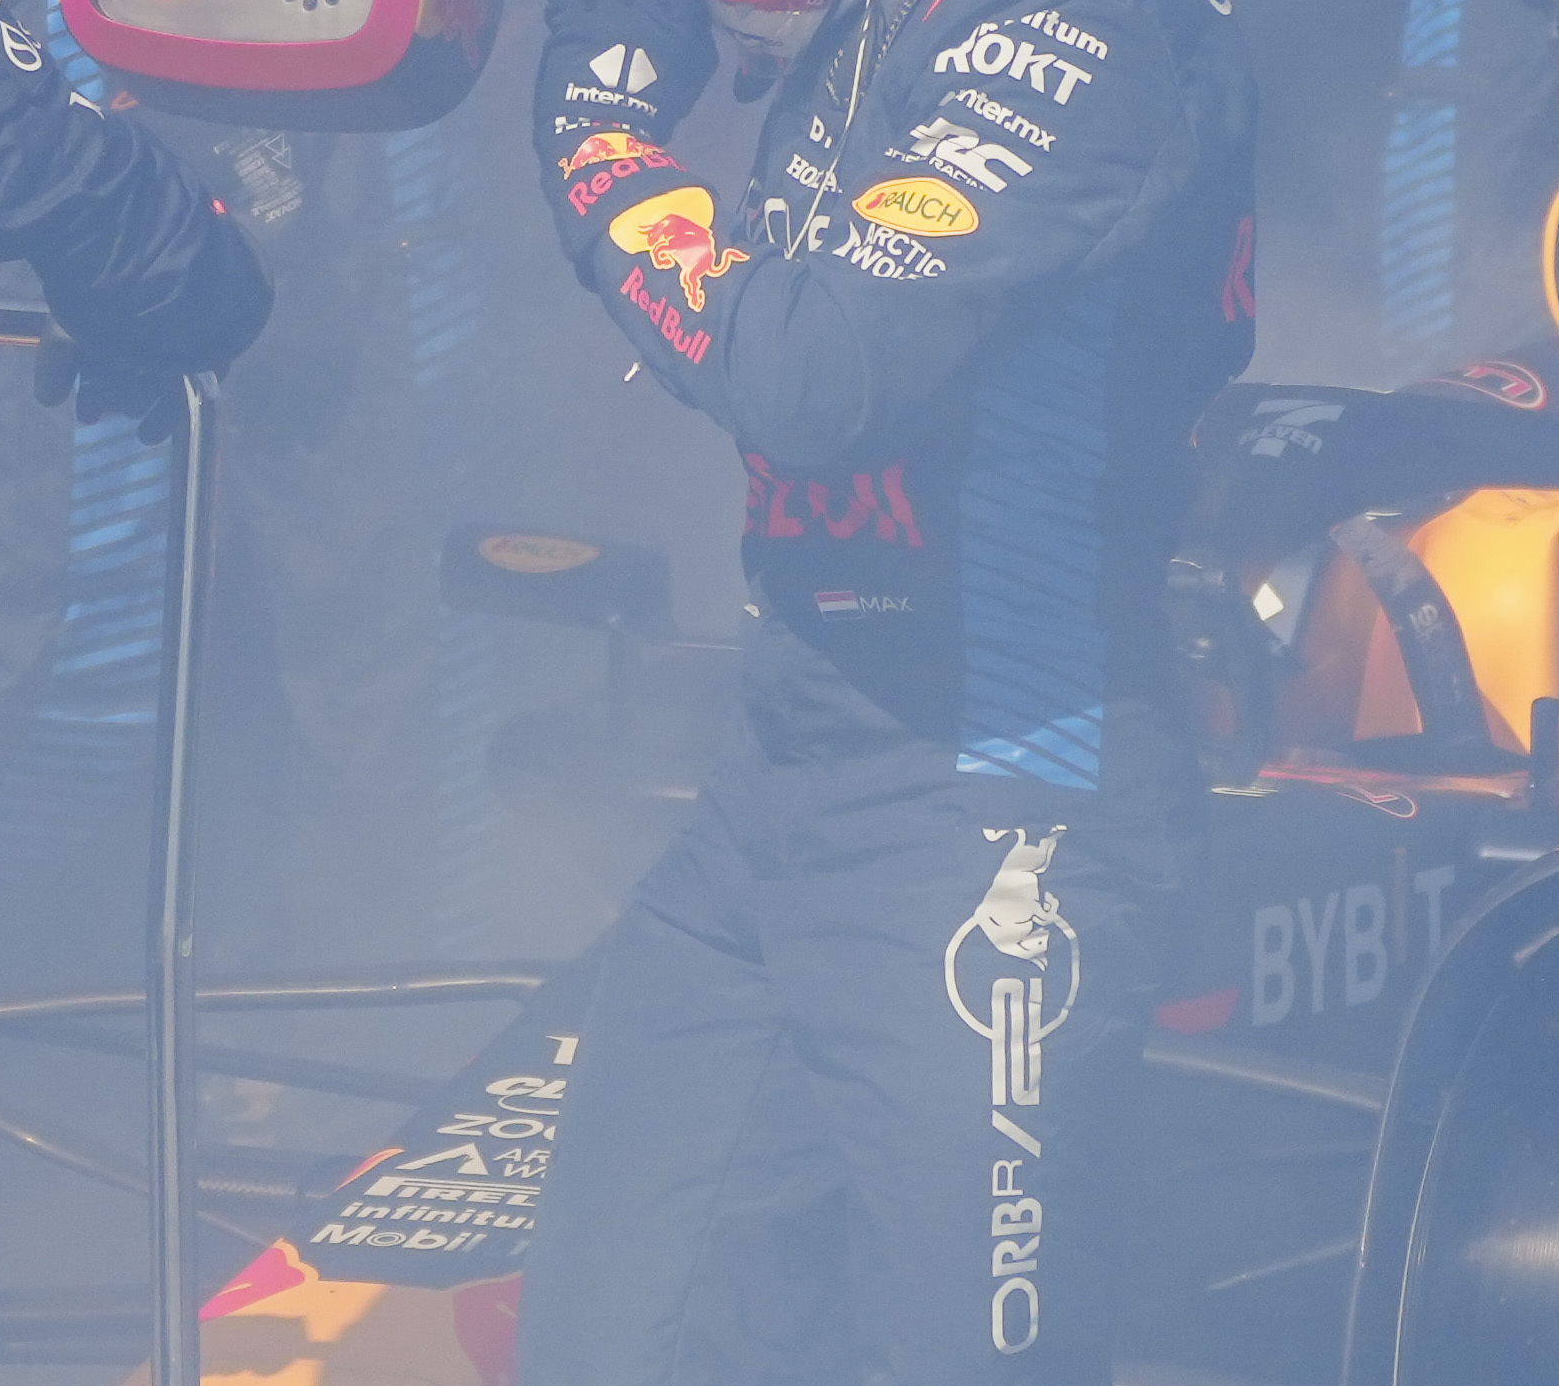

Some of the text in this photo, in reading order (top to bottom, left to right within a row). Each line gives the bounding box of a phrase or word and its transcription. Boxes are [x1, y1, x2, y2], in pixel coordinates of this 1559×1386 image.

[565, 81, 659, 117] inter.mx
[882, 188, 962, 228] RAUCH
[863, 220, 947, 279] ARCTIC
[619, 265, 713, 364] Red Bull
[859, 594, 914, 614] MAX
[1251, 864, 1457, 1027] BYBIT
[309, 1223, 487, 1252] Mobil
